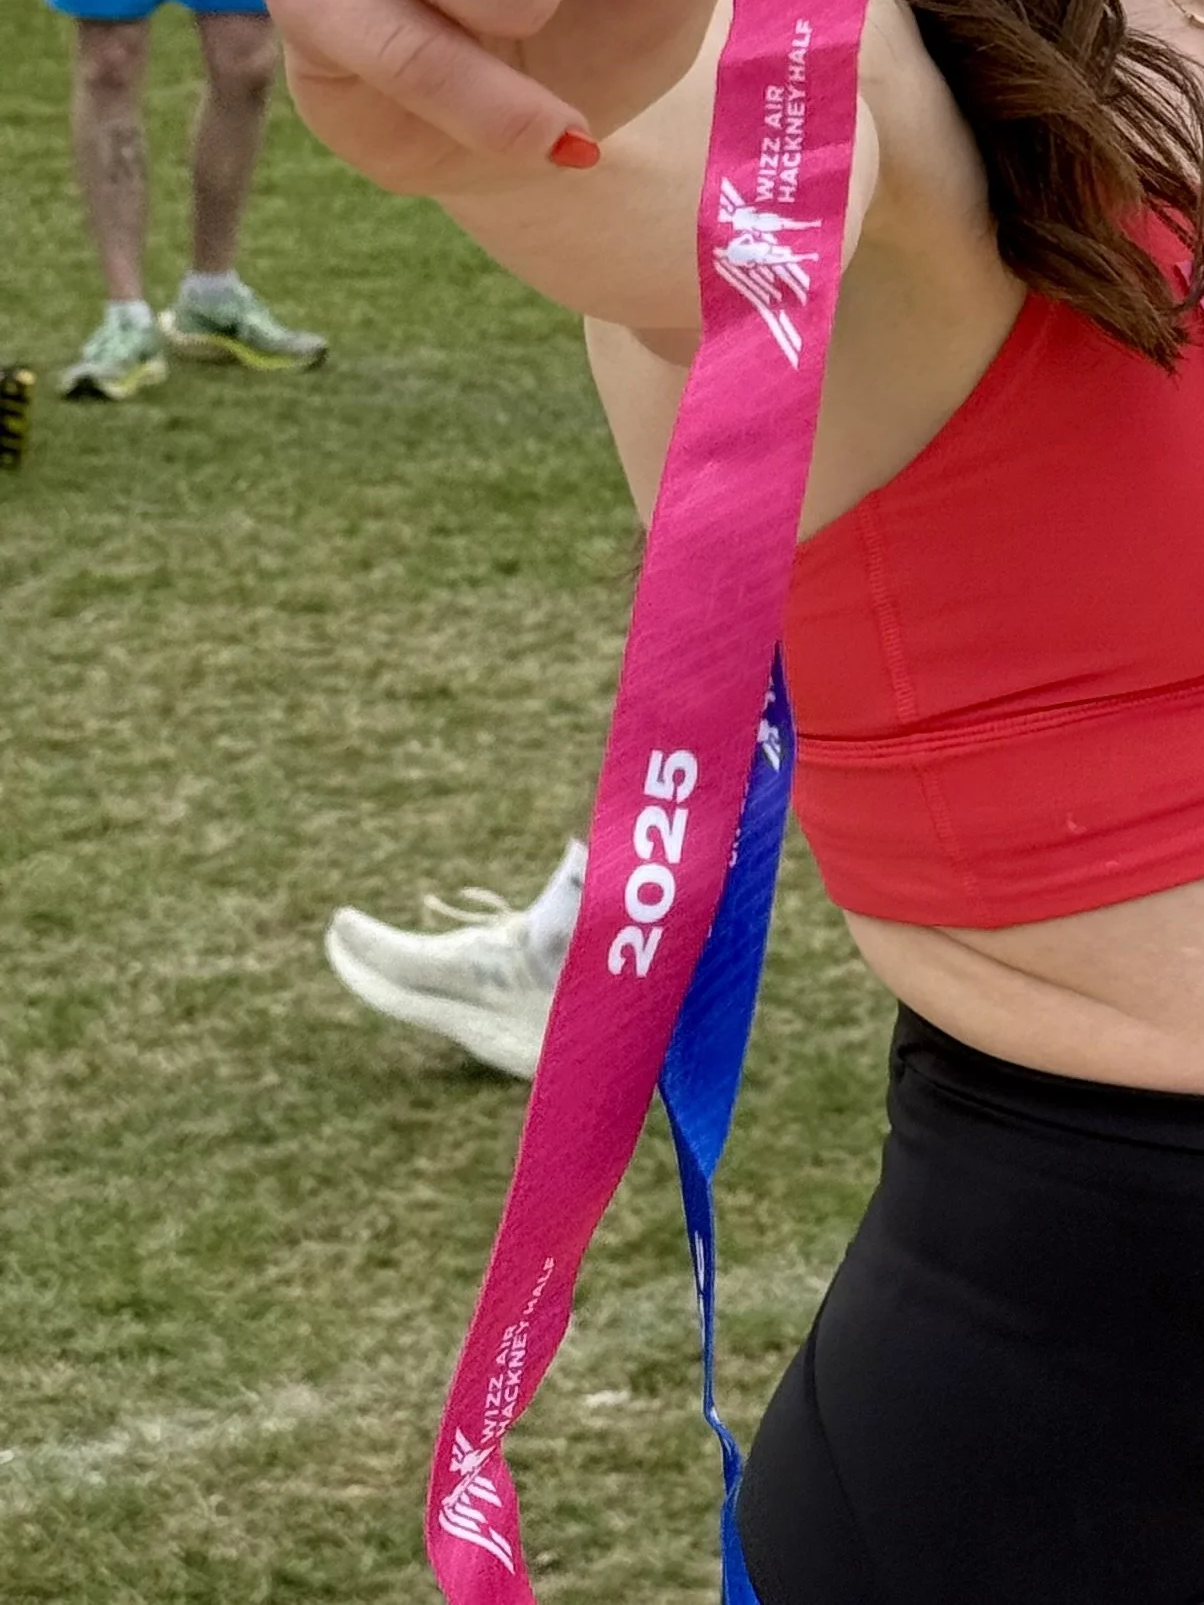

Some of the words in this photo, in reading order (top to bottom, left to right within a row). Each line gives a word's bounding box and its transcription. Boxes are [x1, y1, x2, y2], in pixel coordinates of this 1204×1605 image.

[763, 84, 785, 130] AIR
[787, 18, 812, 82] HALF
[755, 135, 783, 202] WIZZ
[777, 84, 807, 203] HACKNEY
[608, 750, 698, 978] 2025
[480, 1374, 503, 1444] WIZZ
[496, 1325, 517, 1365] AIR
[495, 1321, 529, 1438] HACKNEY
